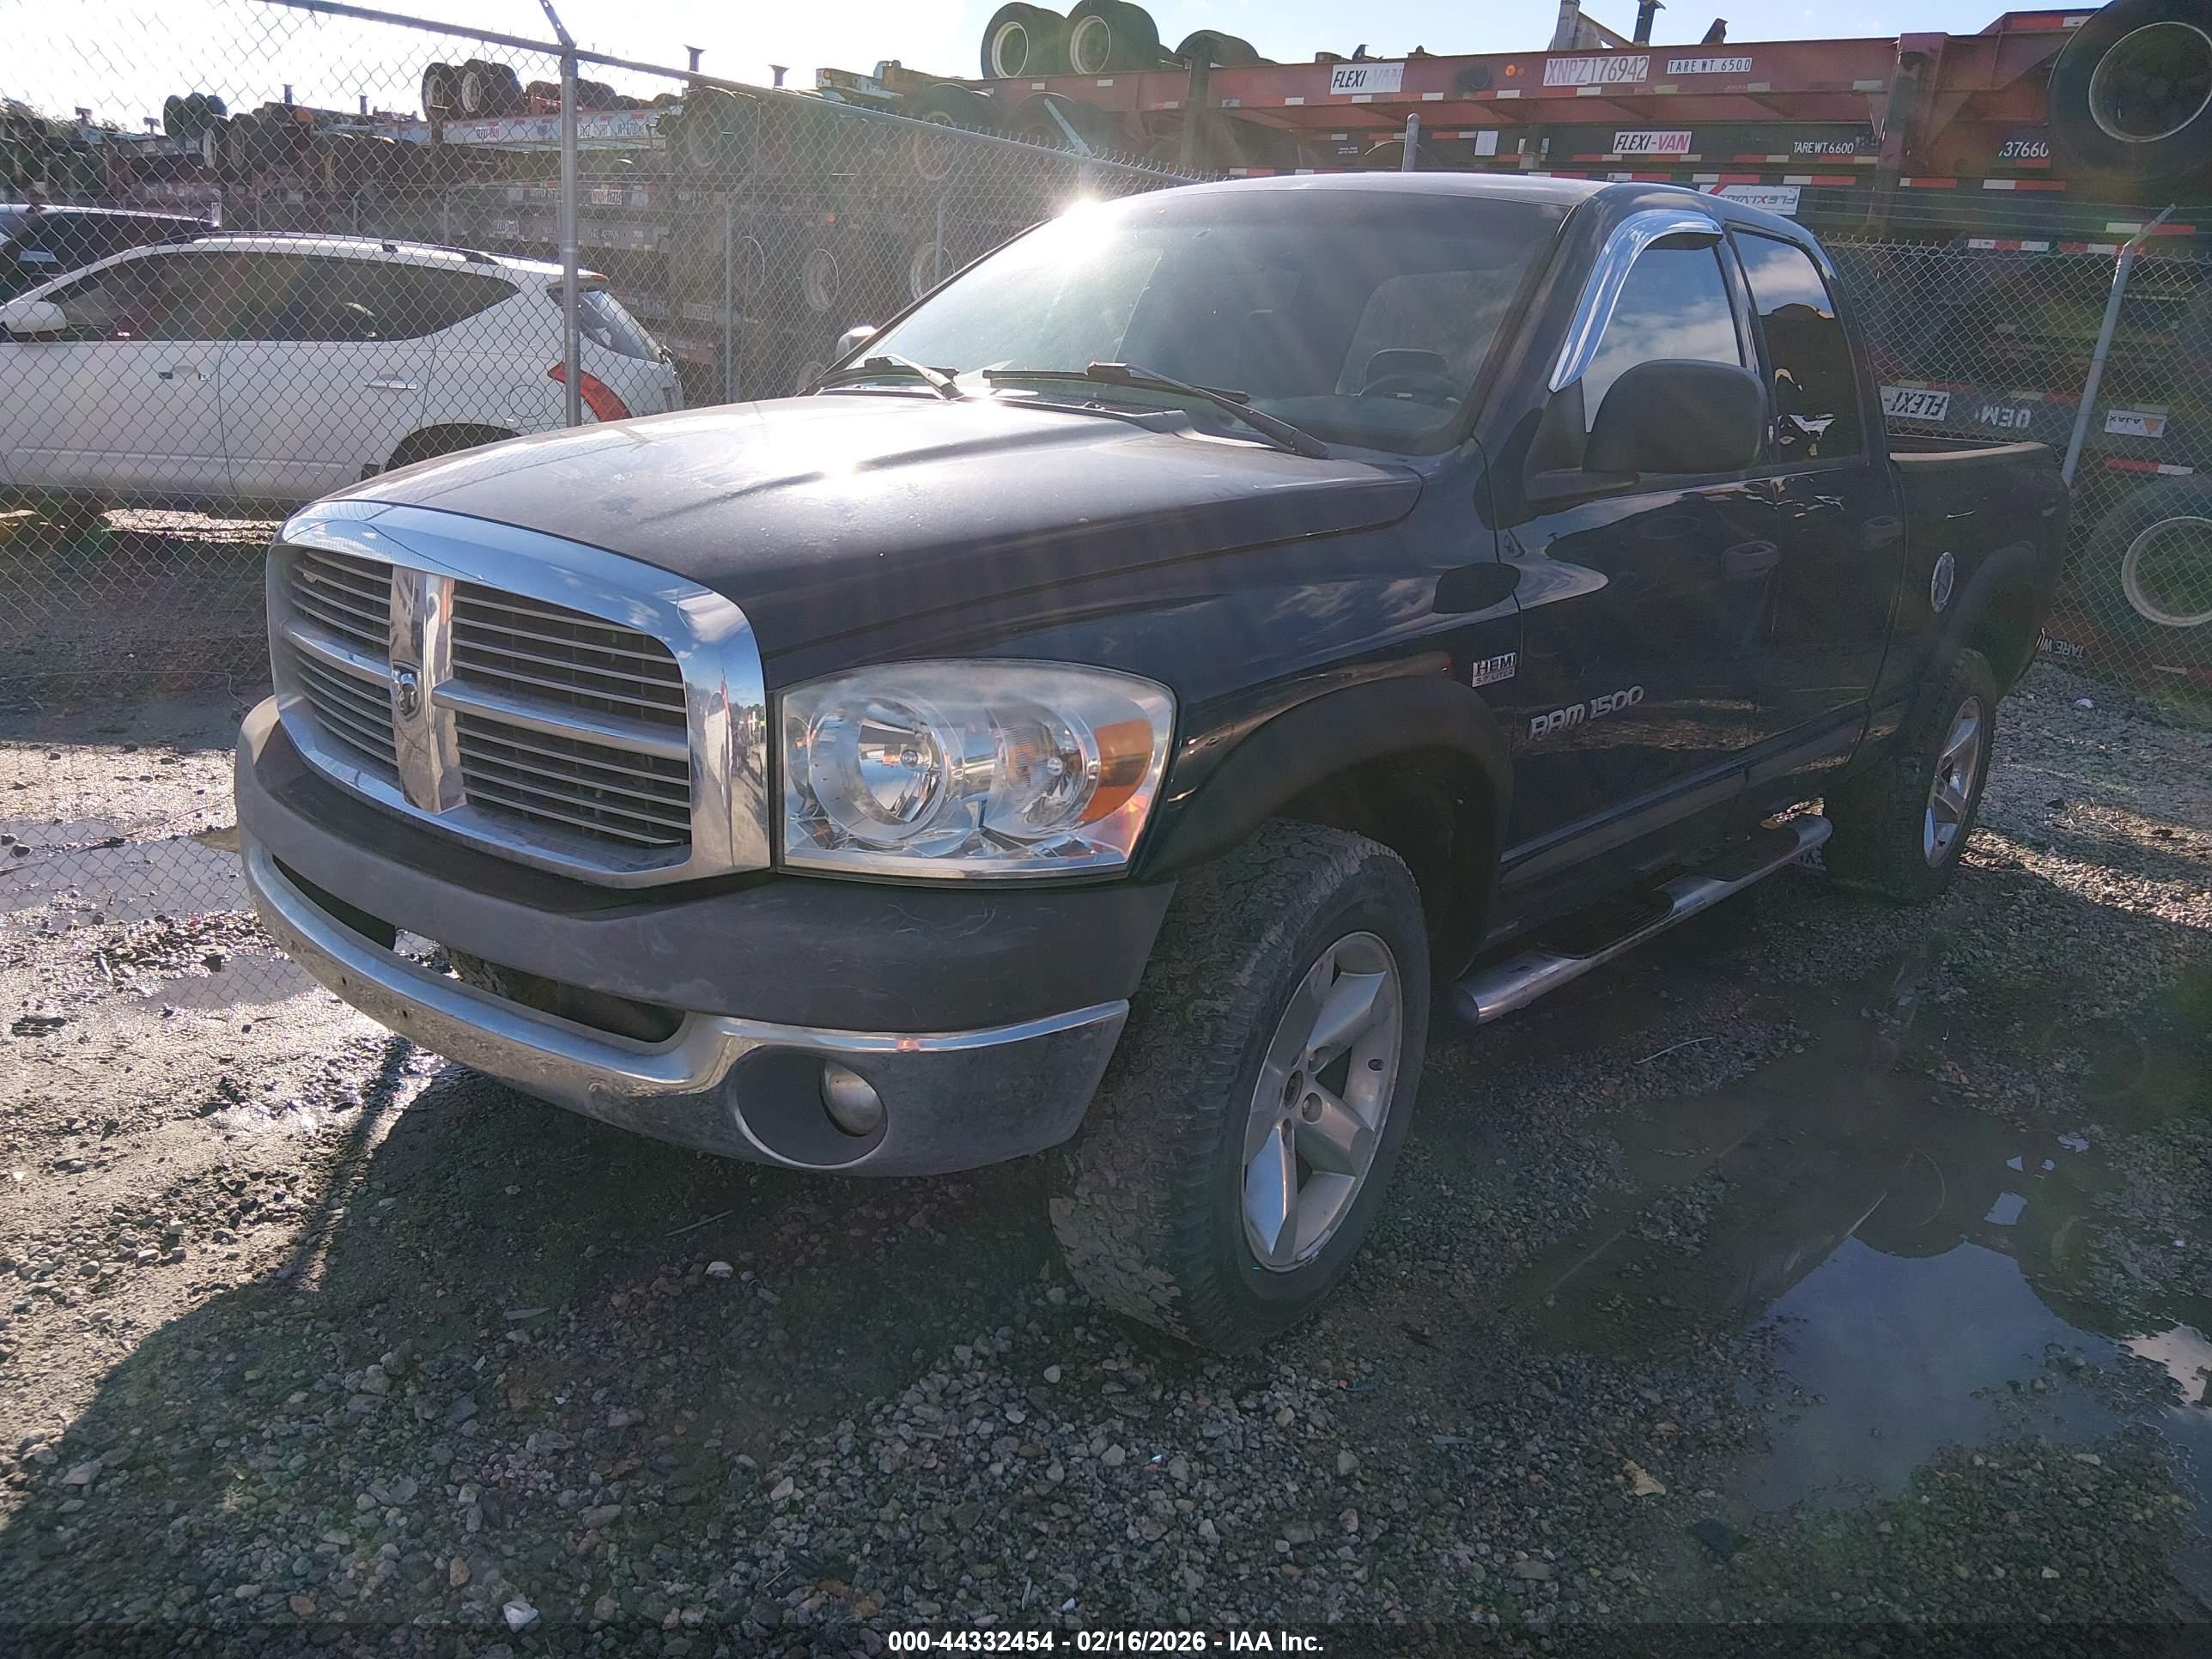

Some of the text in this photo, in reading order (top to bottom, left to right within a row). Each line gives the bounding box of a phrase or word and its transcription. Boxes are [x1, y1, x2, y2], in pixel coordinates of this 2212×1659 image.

[1669, 59, 1750, 72] TARE WT. 6500
[1615, 134, 1690, 150] FLEXI-VAN
[1794, 142, 1814, 153] TARE
[1828, 143, 1854, 154] 6600
[1999, 141, 2049, 157] 37660
[1472, 653, 1516, 676] HEMI
[1528, 685, 1644, 739] RAM 1500
